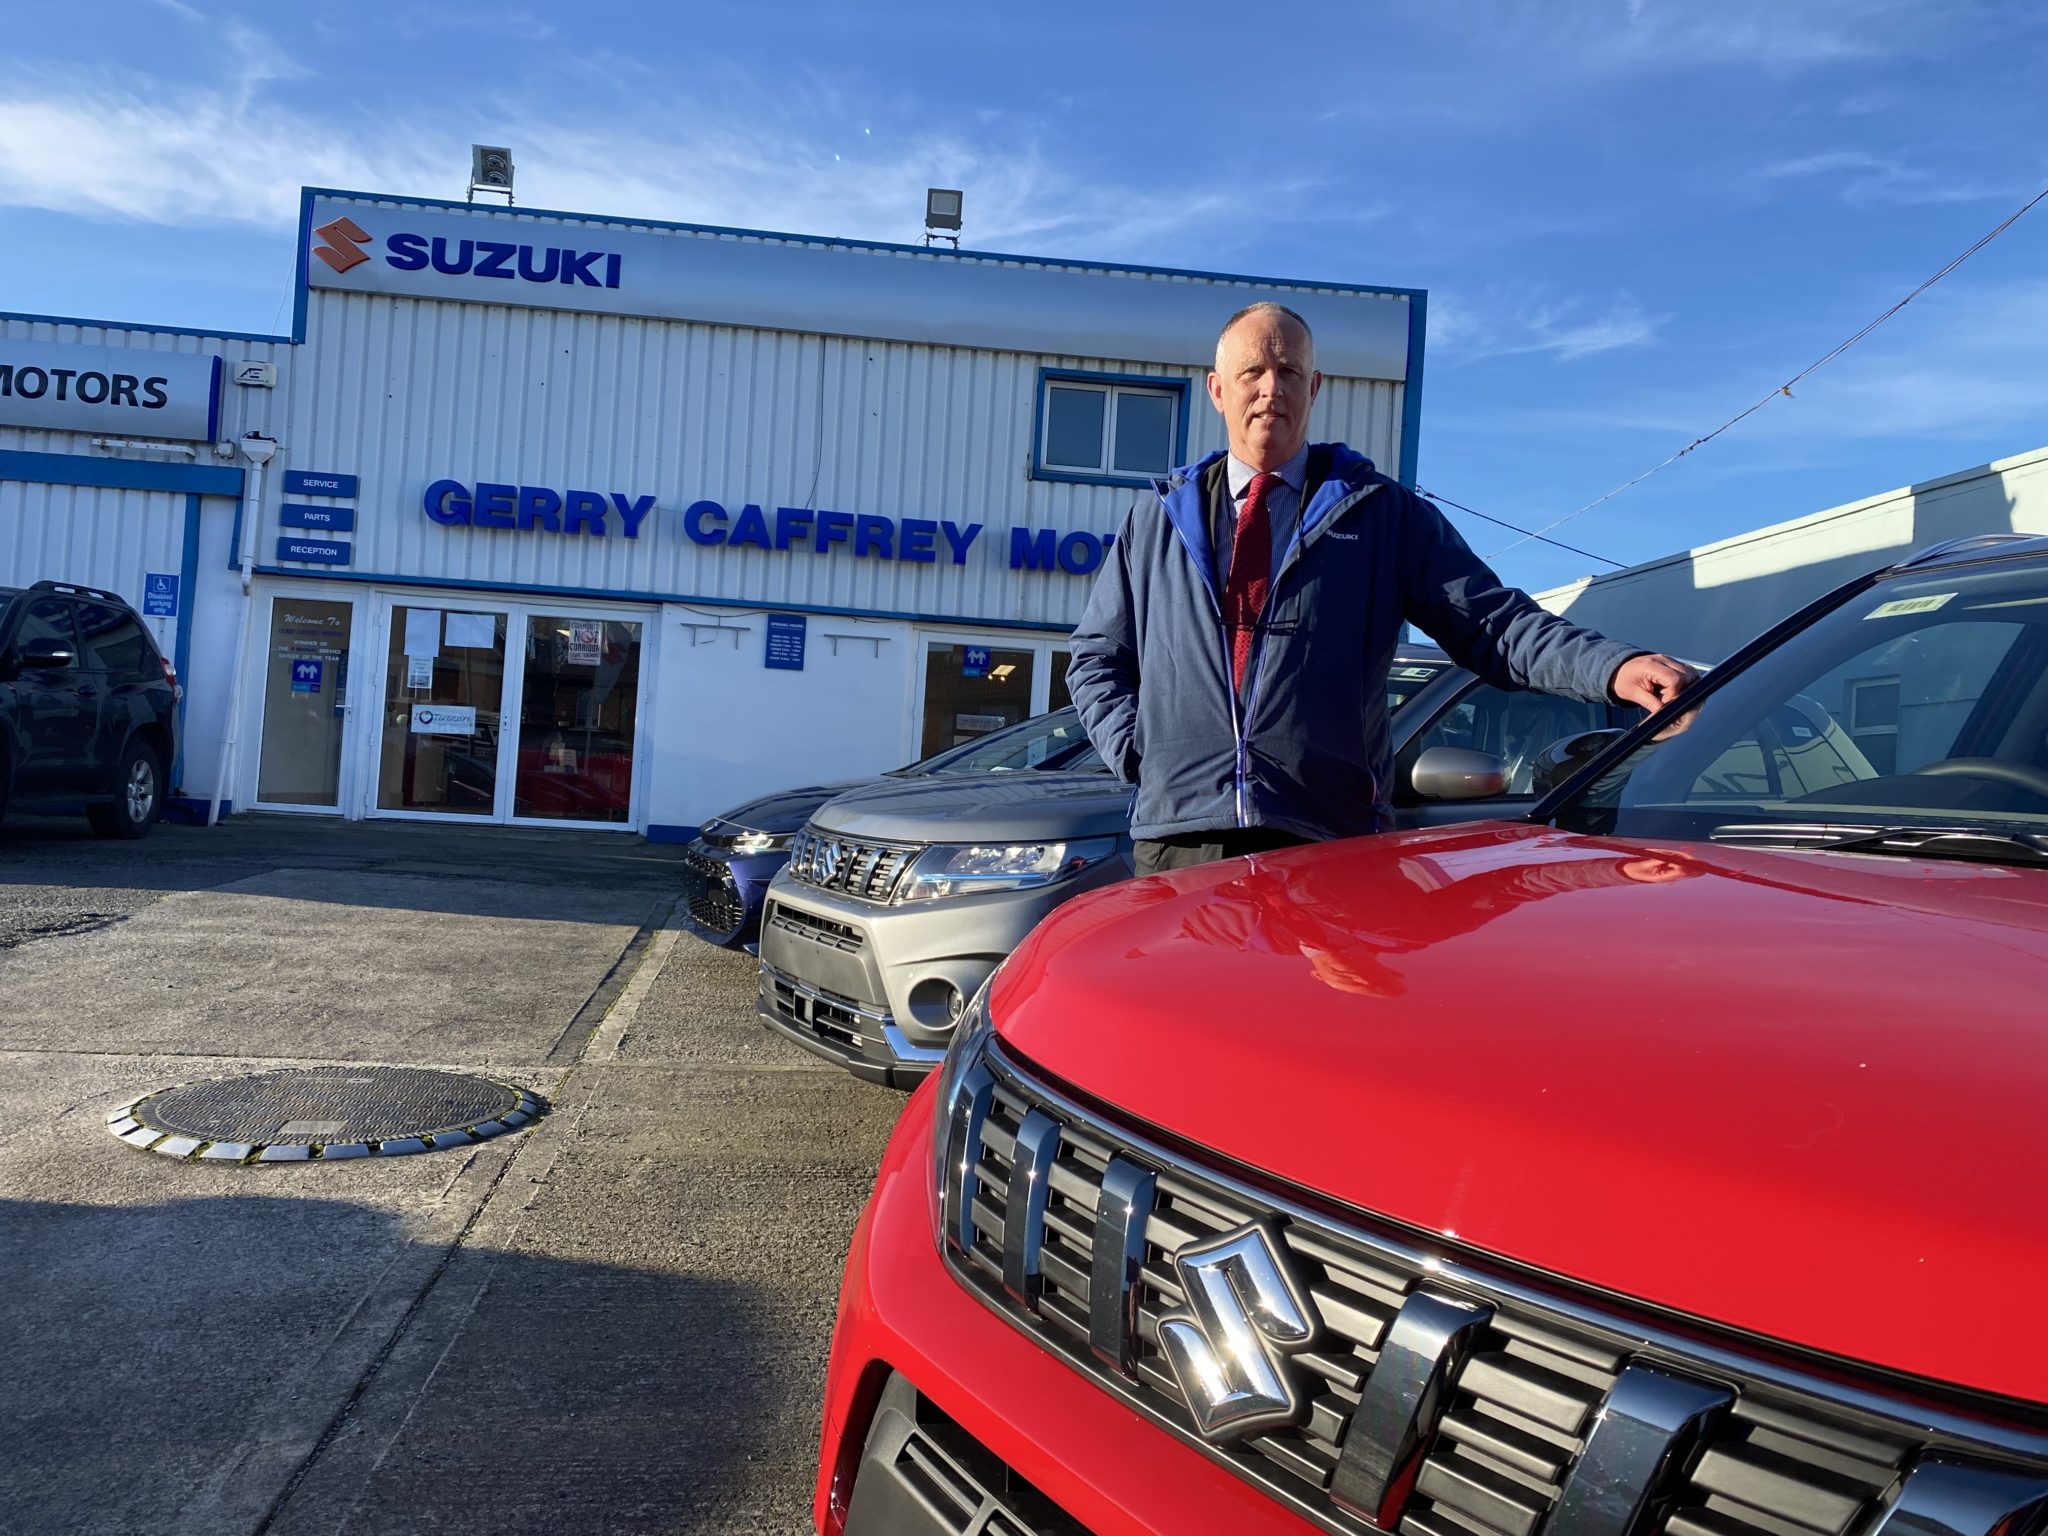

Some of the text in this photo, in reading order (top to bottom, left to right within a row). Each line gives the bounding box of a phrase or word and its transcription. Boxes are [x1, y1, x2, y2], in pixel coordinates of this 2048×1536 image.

[385, 232, 622, 289] SUZUKI
[303, 479, 339, 489] SERVICE
[304, 512, 331, 522] PARTS
[423, 479, 657, 539] GERRY
[683, 500, 984, 566] CAFFREY
[290, 545, 338, 556] RECEPTION
[147, 592, 174, 600] Disabled
[150, 600, 172, 609] parking
[153, 607, 167, 615] only
[284, 614, 340, 626] Welcome To
